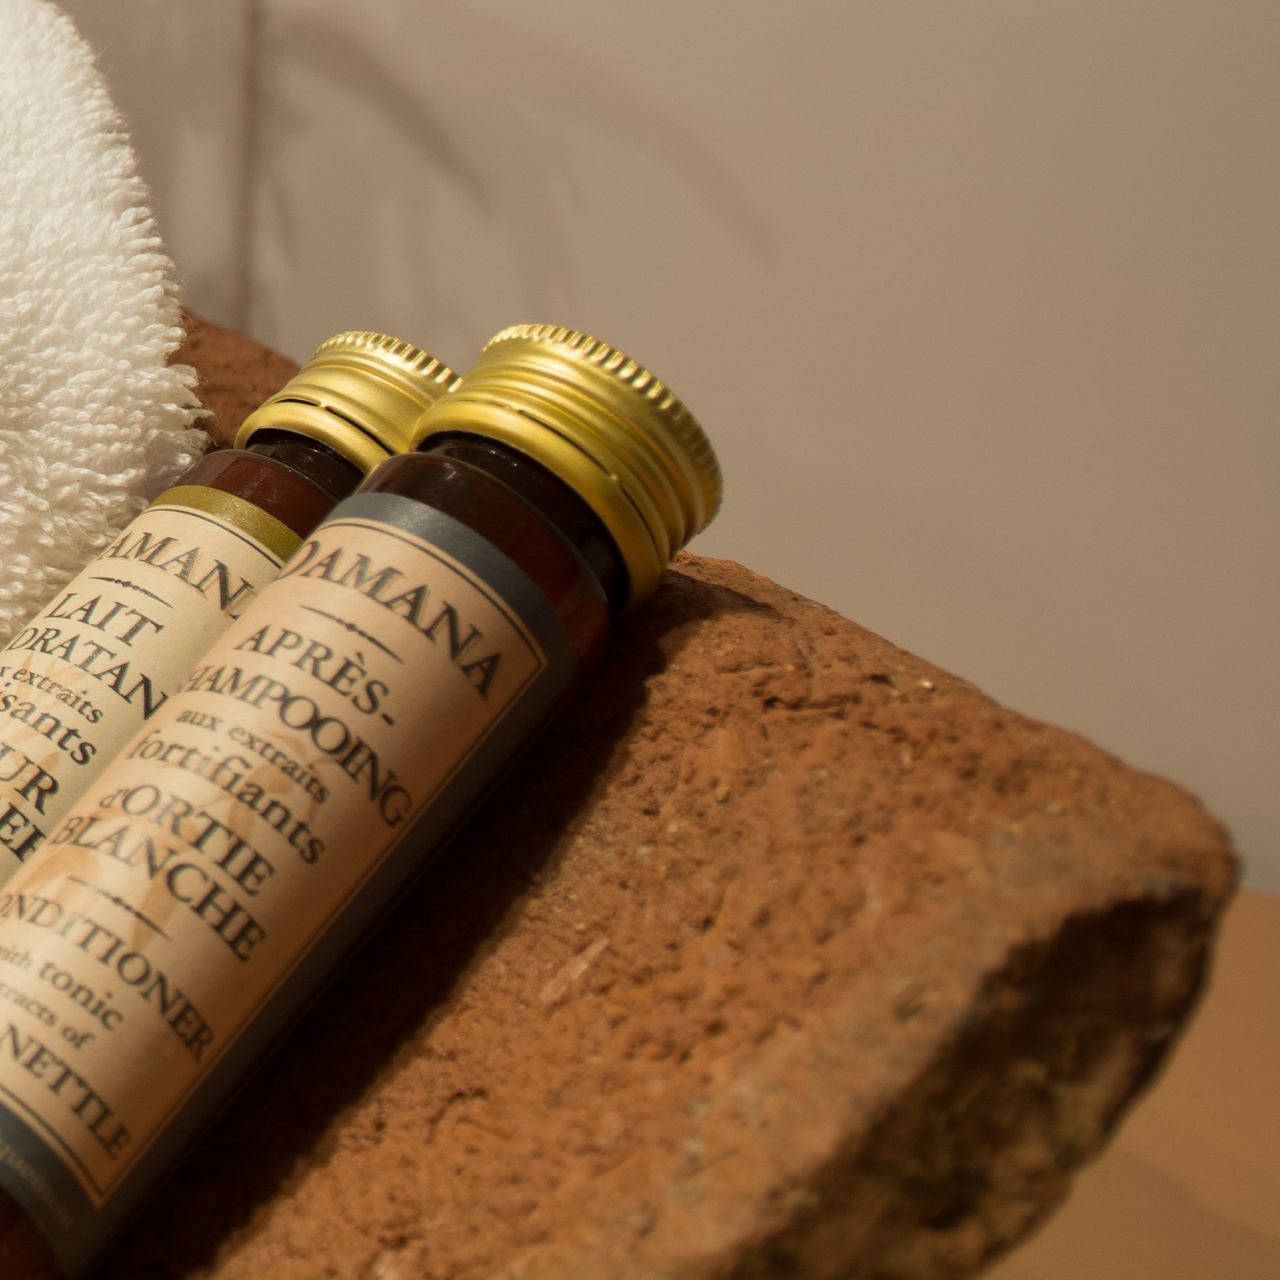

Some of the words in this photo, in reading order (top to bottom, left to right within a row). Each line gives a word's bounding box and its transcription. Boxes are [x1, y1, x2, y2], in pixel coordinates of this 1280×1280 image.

[43, 592, 165, 647] LAIT
[96, 531, 257, 620] AMAN
[6, 627, 170, 721] DRATAN
[11, 665, 104, 724] extraits
[234, 624, 396, 726] APRÈS-
[175, 709, 225, 733] aux
[227, 725, 330, 805] extraits
[183, 665, 413, 827] HAMPOOING
[98, 784, 275, 897] d'ORTIE
[127, 729, 326, 864] fortifiants
[49, 816, 267, 962] BLANCHE
[40, 961, 124, 1031] tonic
[61, 1026, 96, 1051] of
